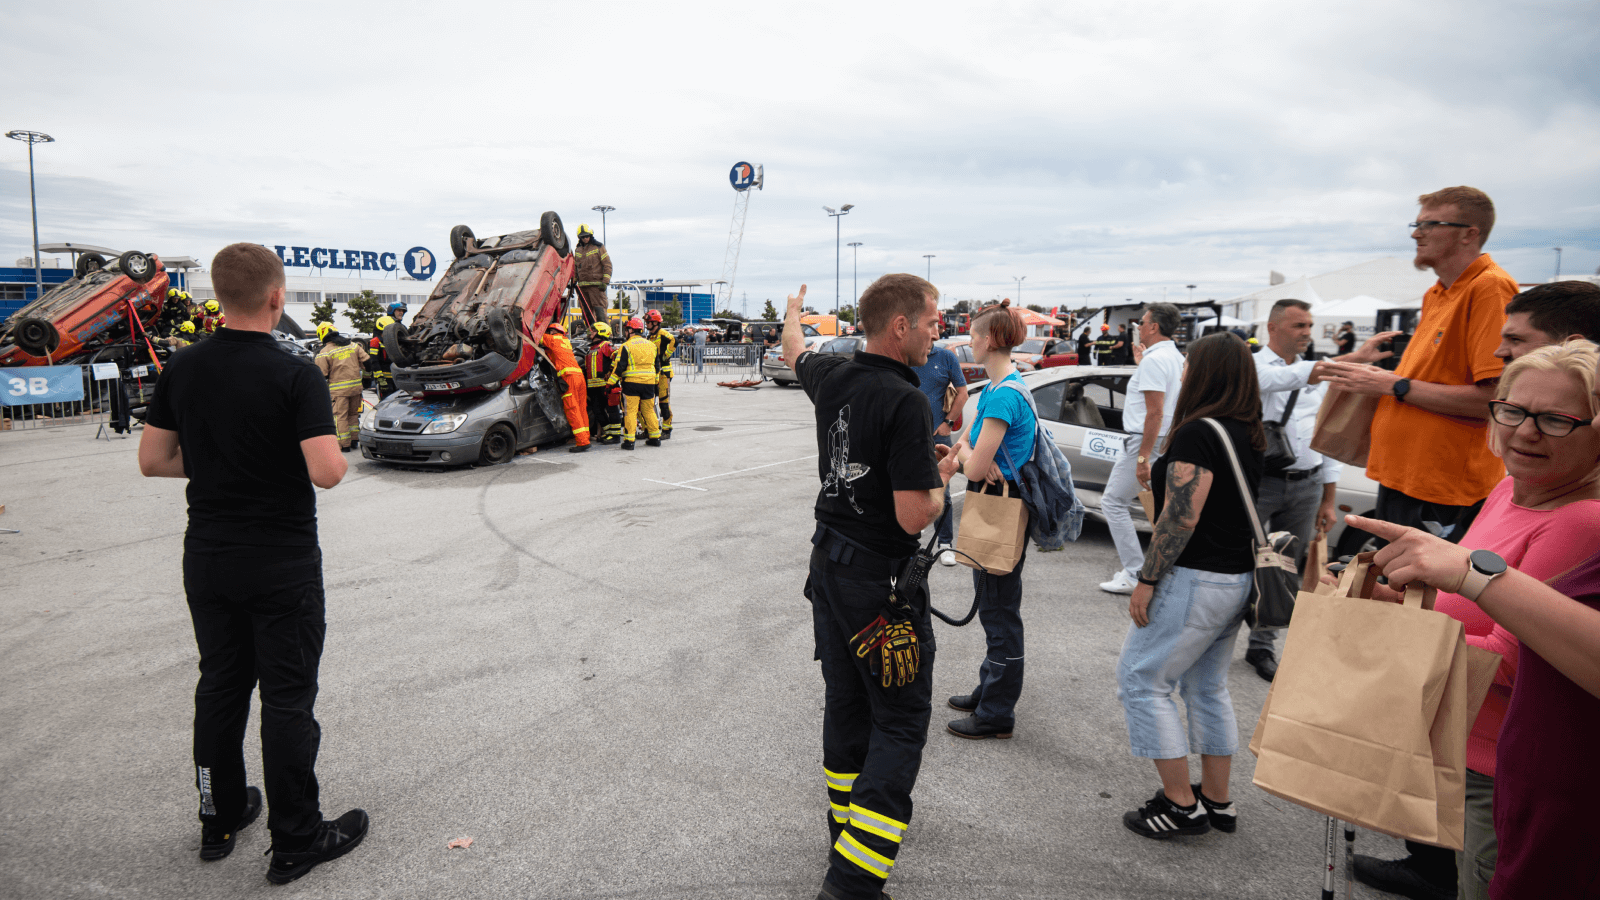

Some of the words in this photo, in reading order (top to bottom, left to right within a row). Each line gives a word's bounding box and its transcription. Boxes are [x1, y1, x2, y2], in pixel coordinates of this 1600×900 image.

[275, 245, 396, 271] LECLERC
[8, 377, 49, 396] 3B
[1088, 431, 1118, 440] SUPPORTED
[1089, 438, 1119, 456] GET
